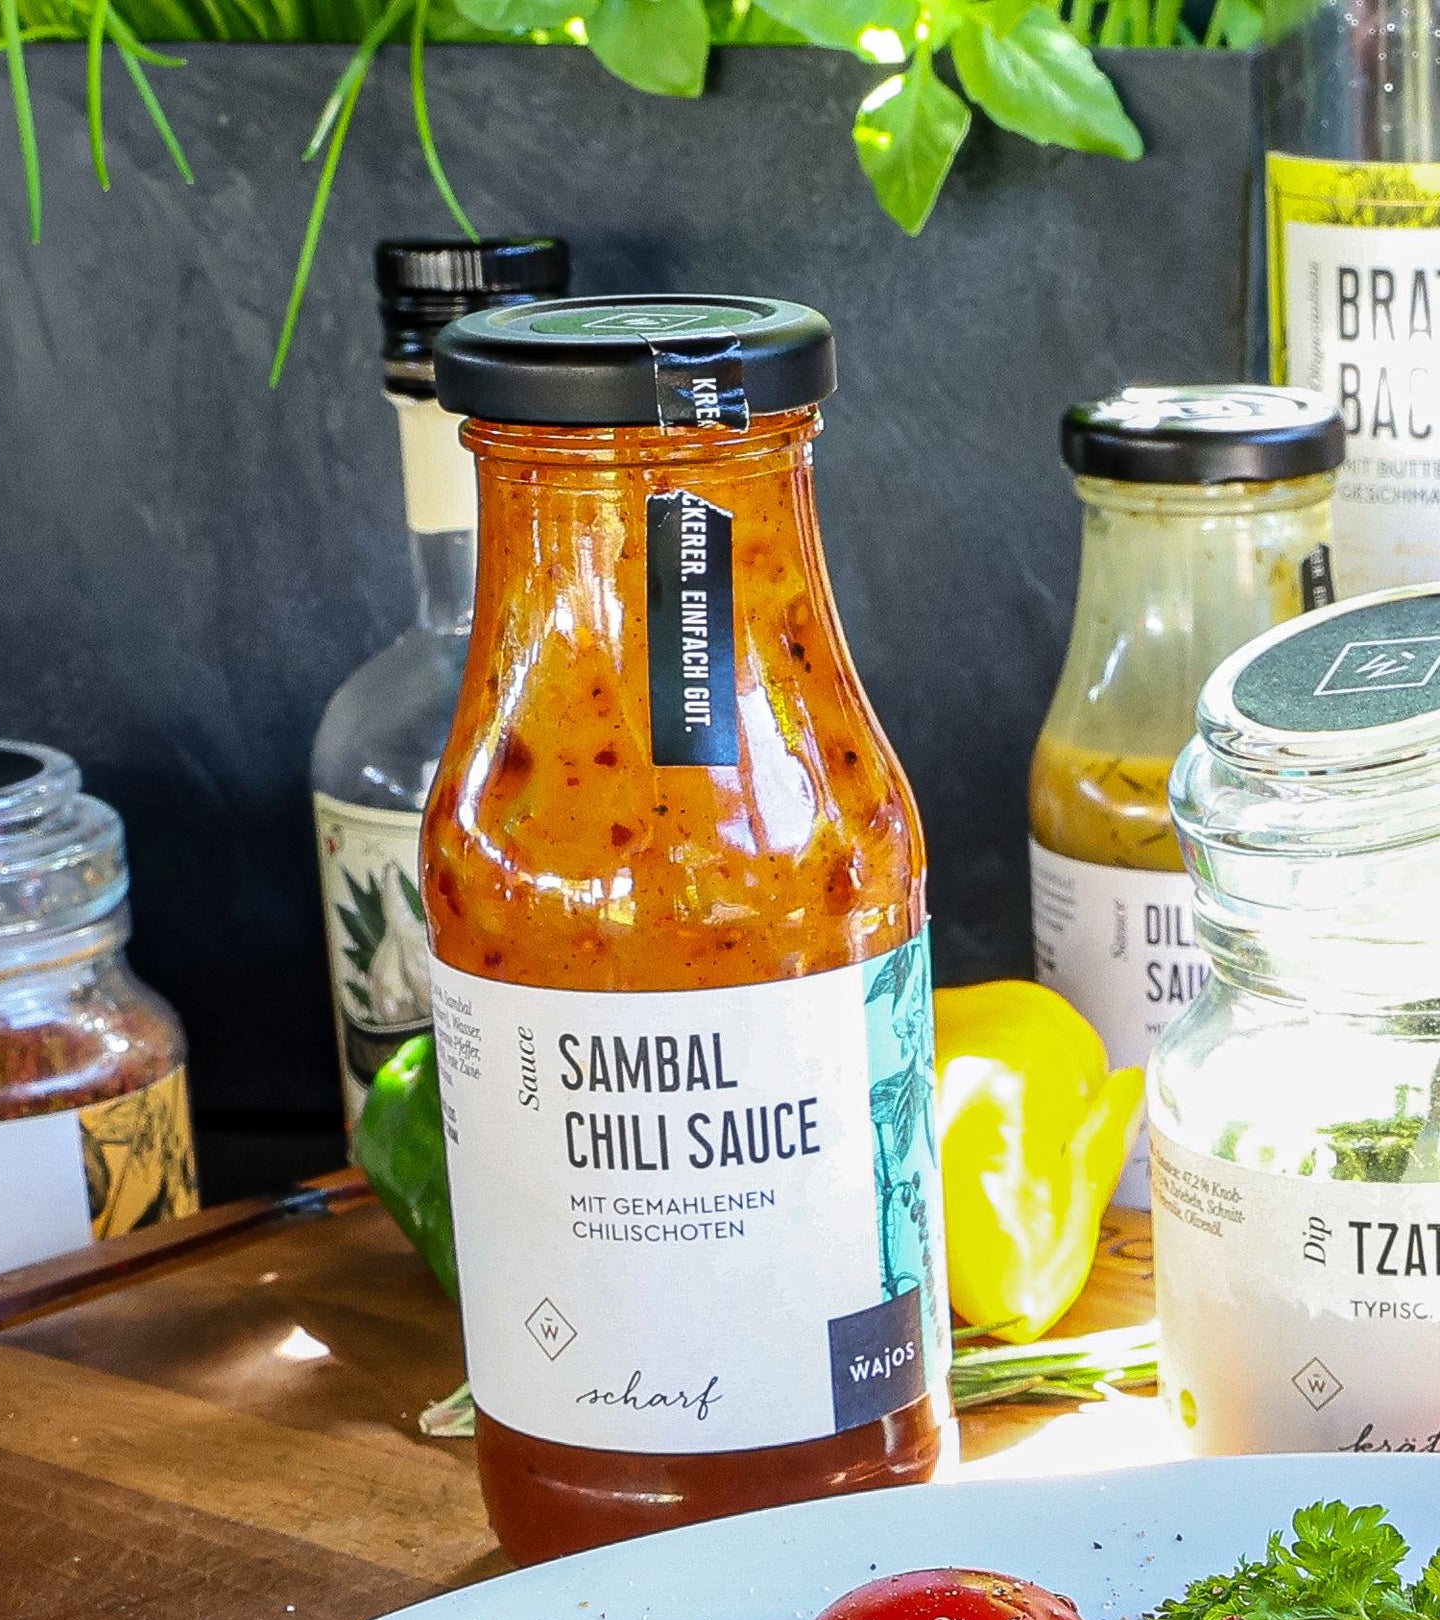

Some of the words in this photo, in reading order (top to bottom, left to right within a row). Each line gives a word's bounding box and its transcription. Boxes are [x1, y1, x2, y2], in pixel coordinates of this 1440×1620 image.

[692, 377, 721, 428] KREA
[681, 493, 707, 582] CKERER.
[682, 590, 708, 680] EINFACH
[683, 687, 710, 733] GUT.
[518, 1026, 540, 1112] Sauce
[558, 1032, 738, 1095] SAMBAL
[565, 1109, 671, 1172] CHILI
[688, 1097, 821, 1170] SAUCE
[570, 1194, 607, 1215] MIT
[613, 1189, 776, 1217] GEMAHLENEN
[571, 1220, 746, 1243] CHILISCHOTEN
[1303, 1216, 1333, 1267] Dip
[1350, 1299, 1433, 1320] TYPISC
[574, 1370, 723, 1420] scharf
